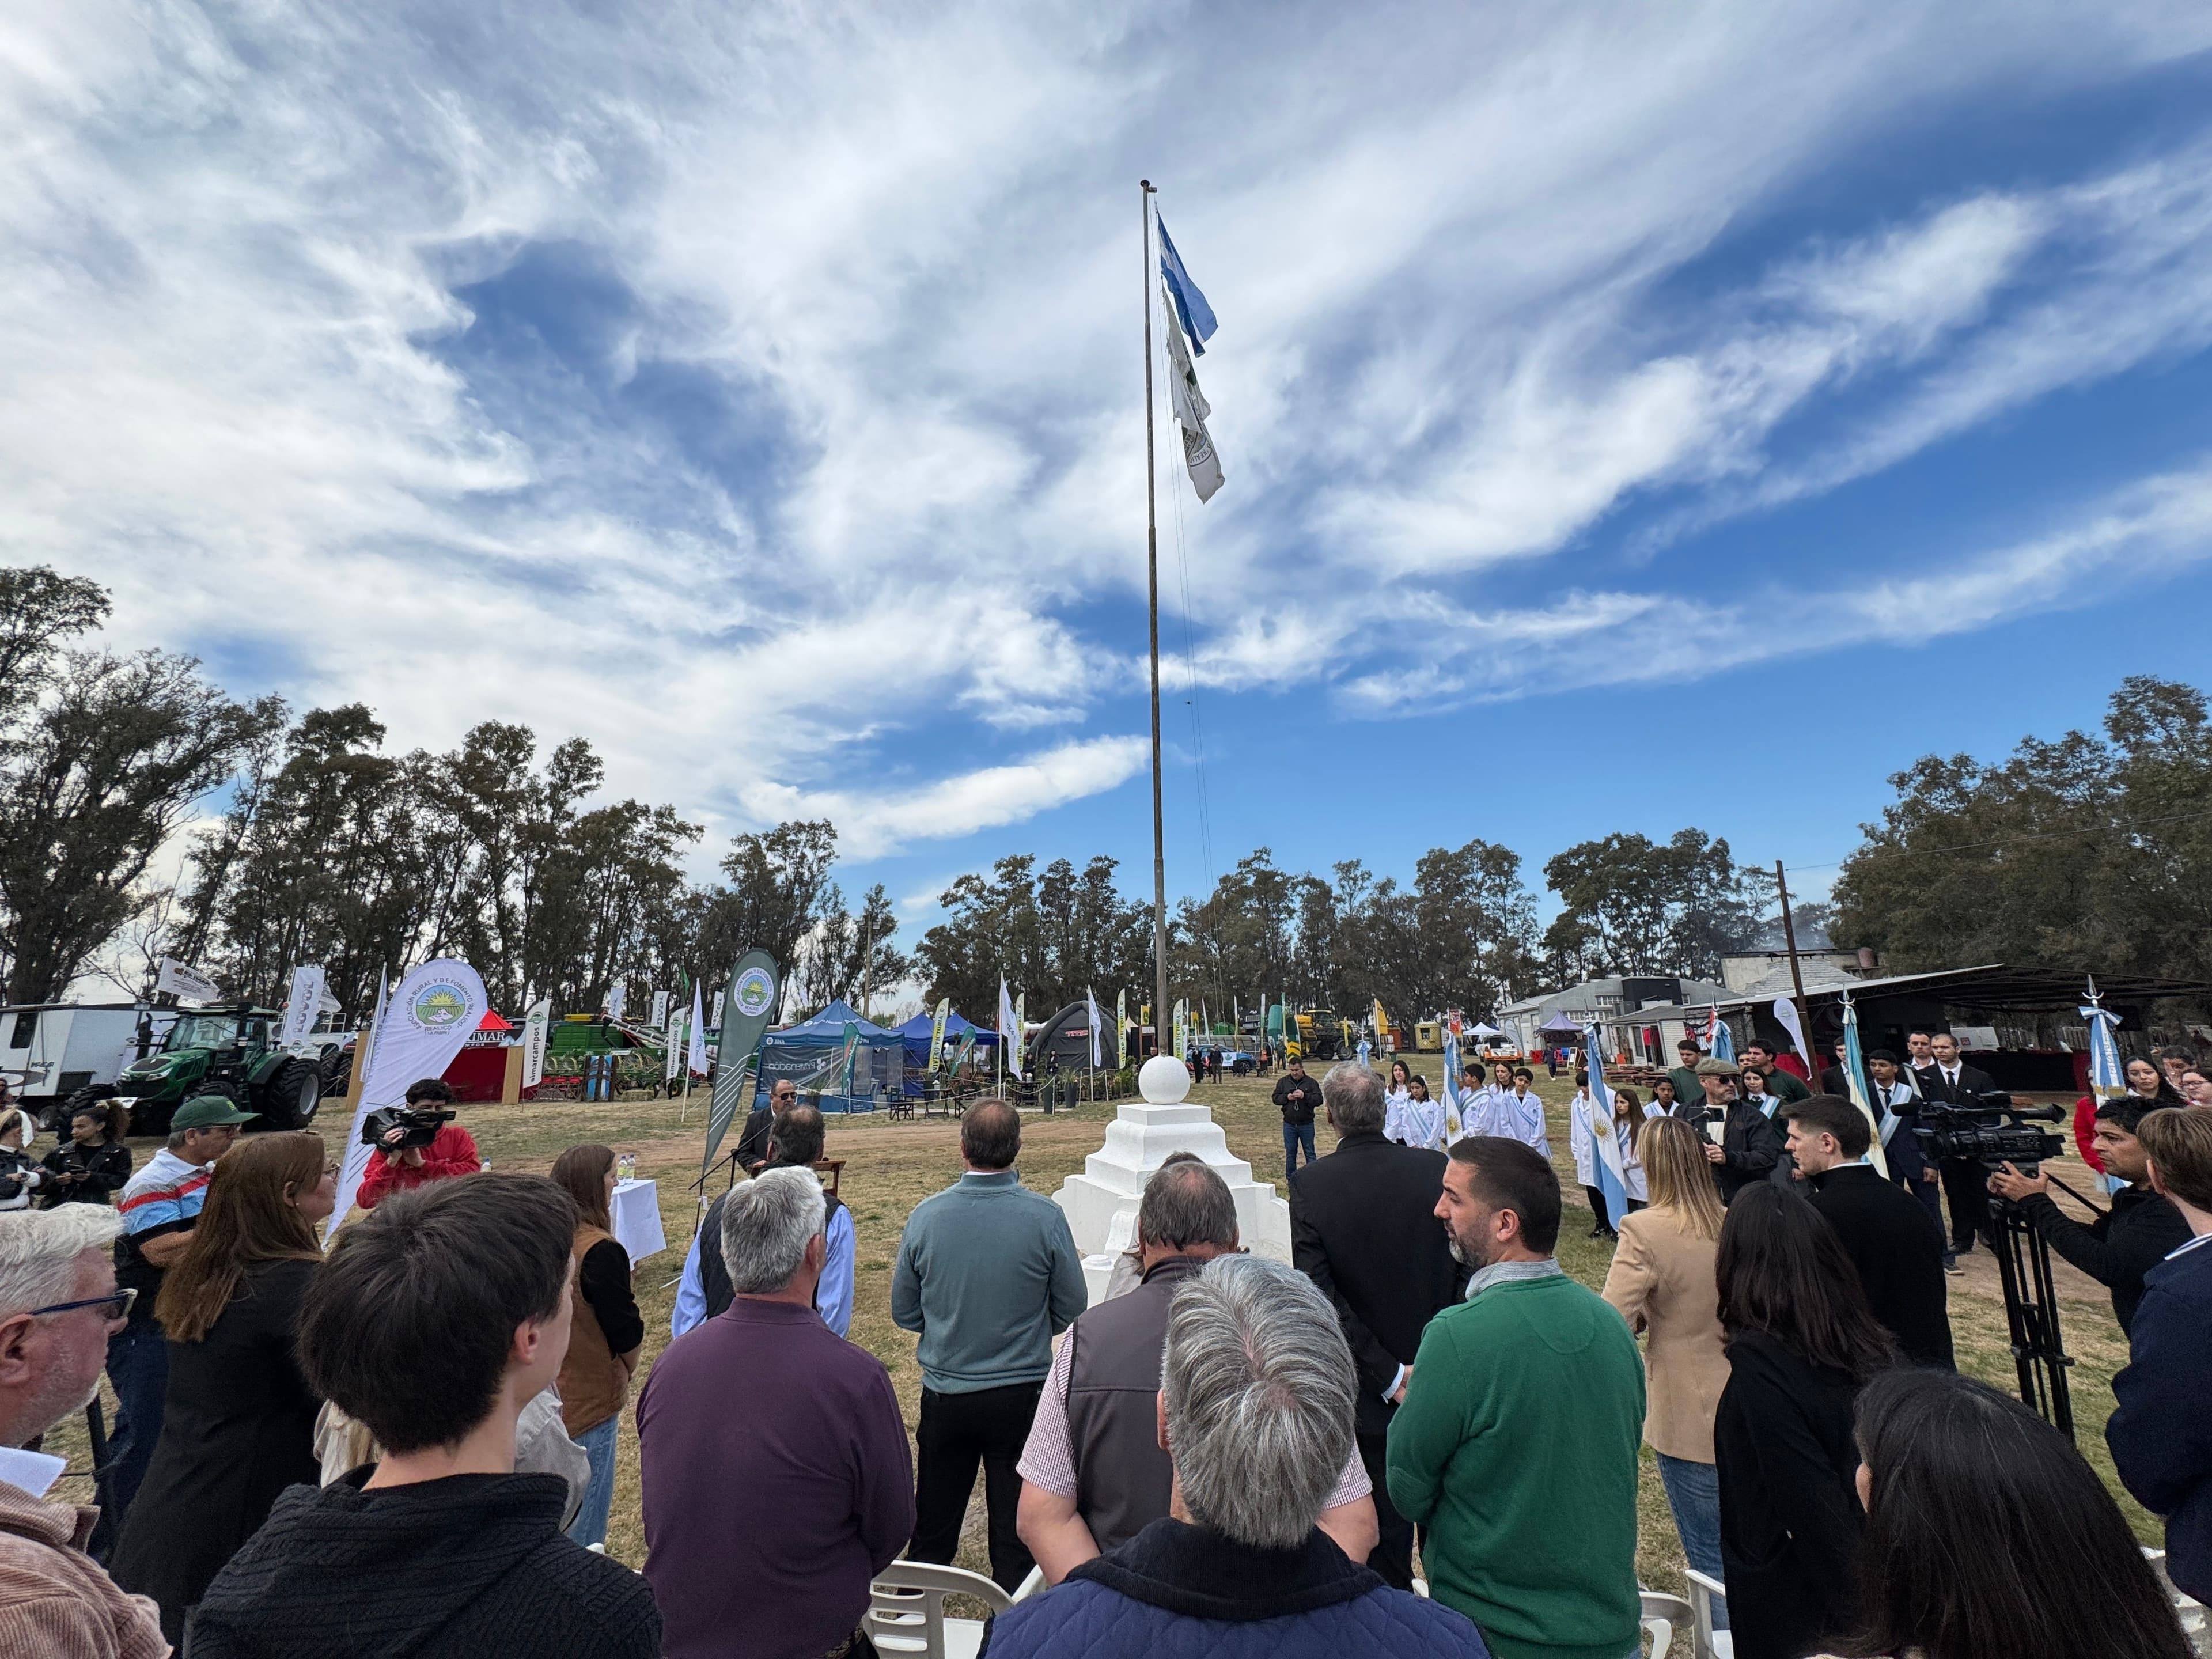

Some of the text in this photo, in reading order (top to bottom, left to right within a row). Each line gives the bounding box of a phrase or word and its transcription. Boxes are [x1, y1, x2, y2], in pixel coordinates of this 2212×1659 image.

[412, 980, 432, 996] RURAL
[450, 979, 473, 1002] FOMENTO
[934, 1016, 943, 1047] VICTORIA
[530, 1027, 541, 1082] aimarcampos
